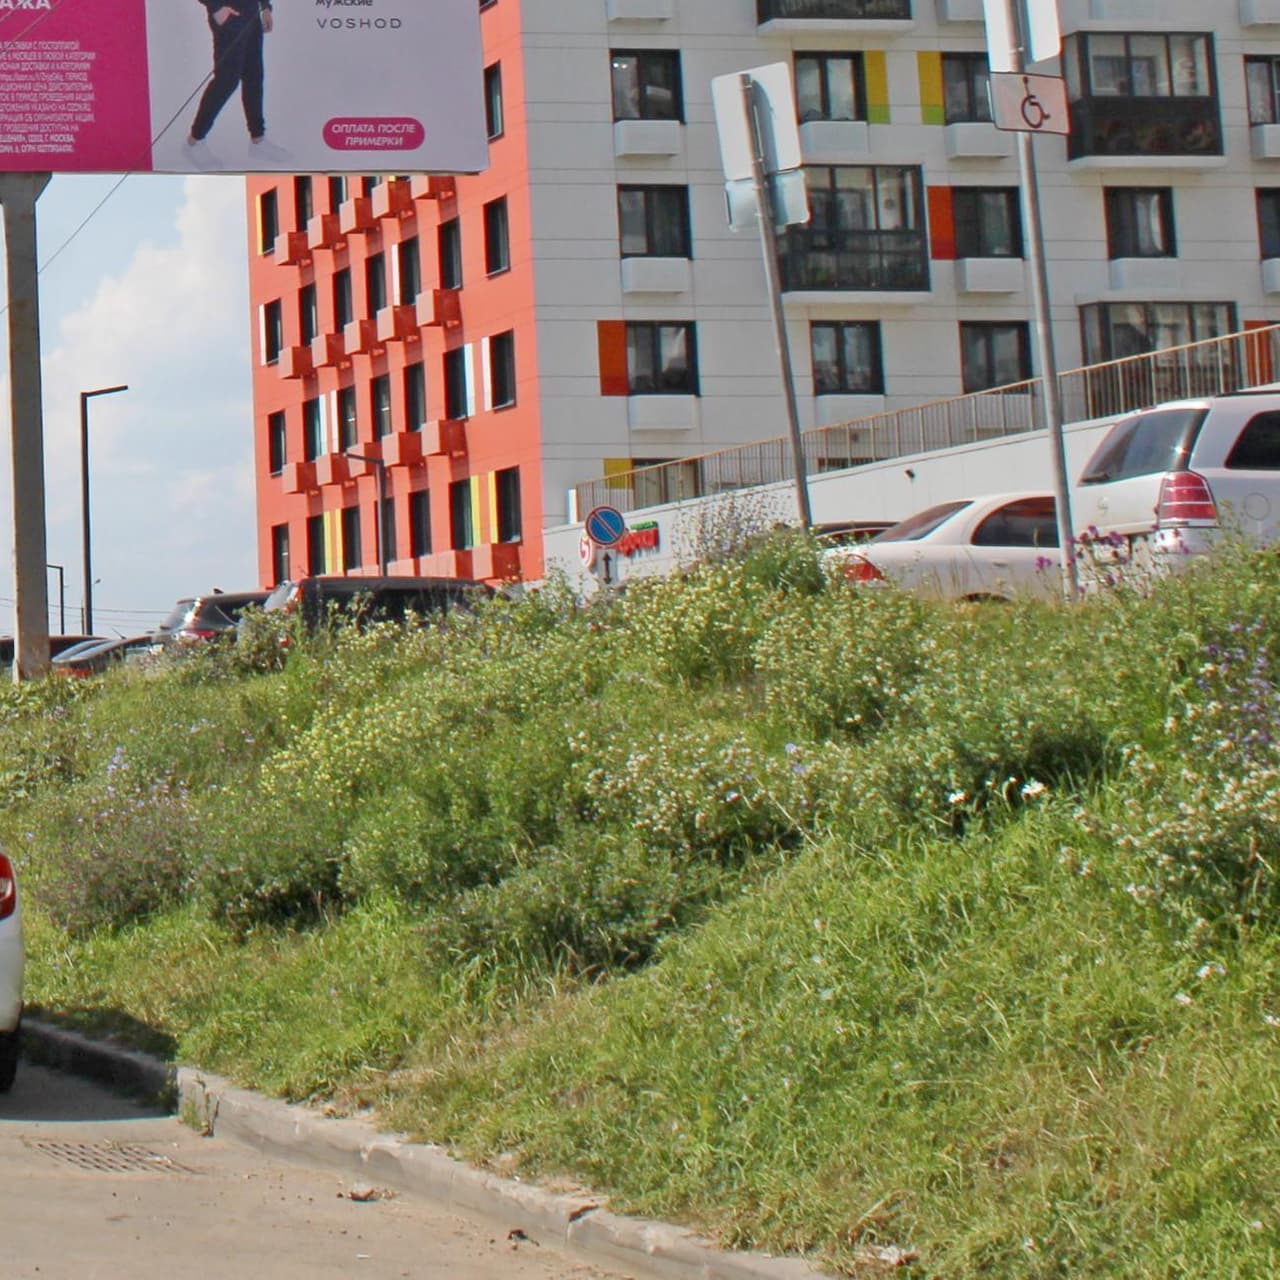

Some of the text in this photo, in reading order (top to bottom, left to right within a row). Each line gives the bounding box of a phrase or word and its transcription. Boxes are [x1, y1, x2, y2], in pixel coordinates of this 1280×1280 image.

[316, 18, 402, 29] VOSHOD
[331, 123, 416, 133] ОПЛАТА ПОСЛЕ
[345, 136, 403, 146] ПРИМЕРКИ
